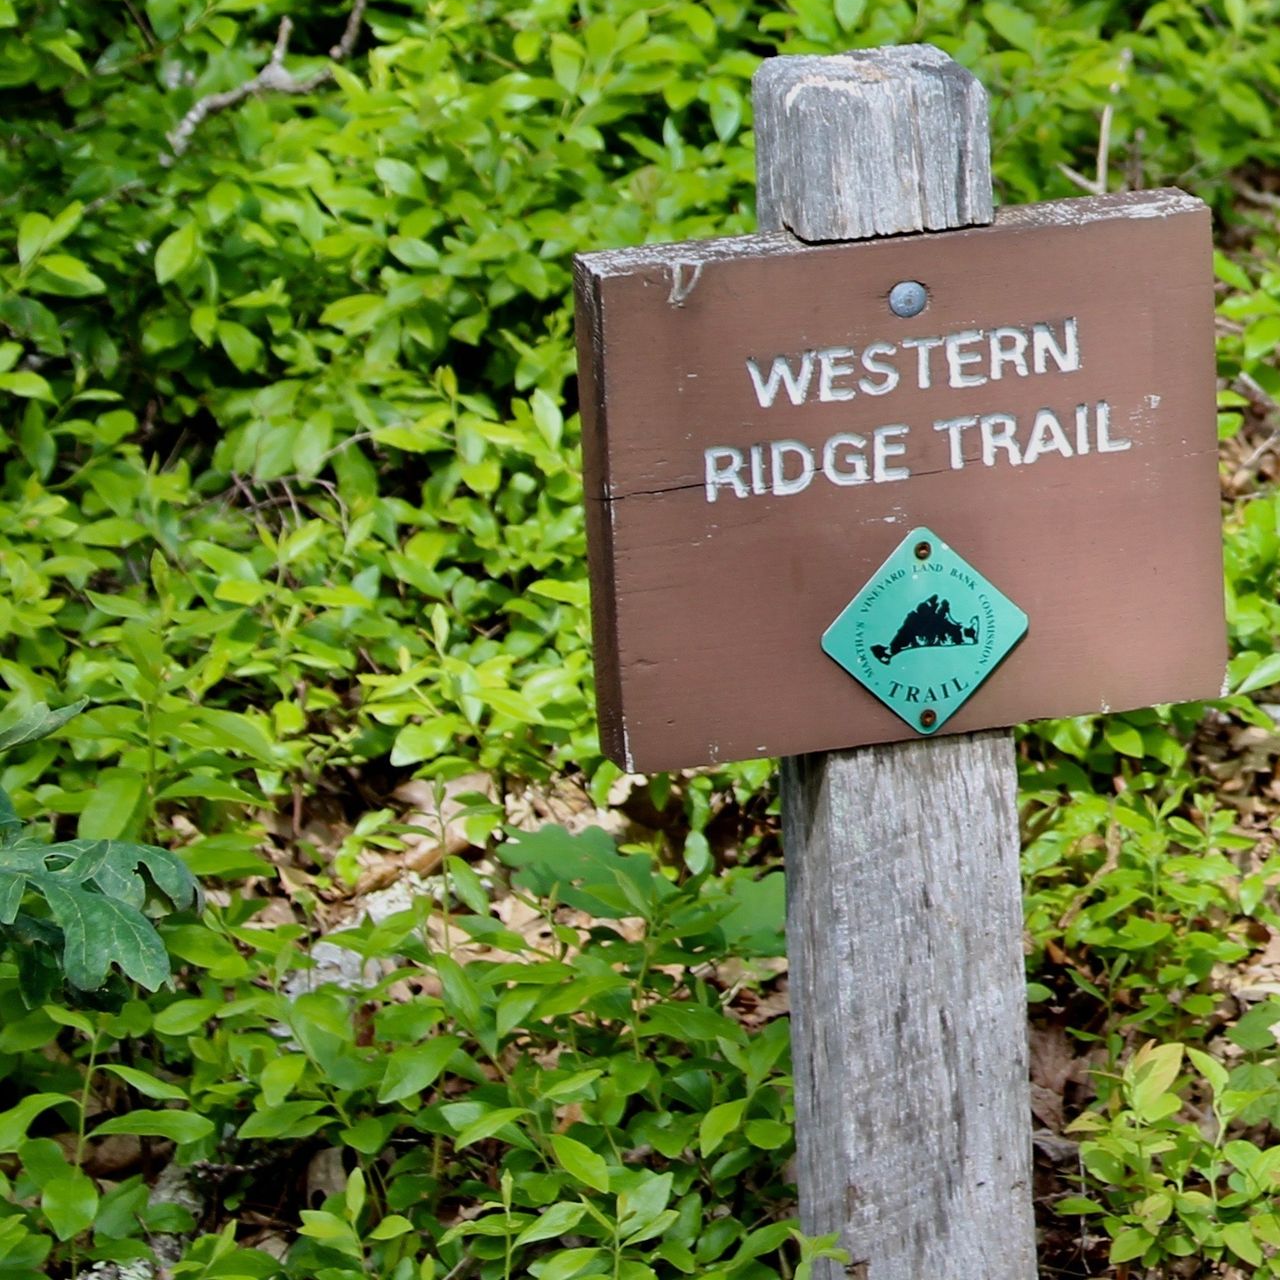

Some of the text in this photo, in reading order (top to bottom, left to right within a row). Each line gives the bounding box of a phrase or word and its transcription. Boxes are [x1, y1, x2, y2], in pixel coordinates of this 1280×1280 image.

[746, 317, 1082, 407] WESTERN
[704, 400, 1132, 502] RIDGE TRAIL
[854, 562, 996, 679] MARTHA'S VINEYARD LAND BANK COMMISSION
[887, 677, 969, 704] TRAIL
